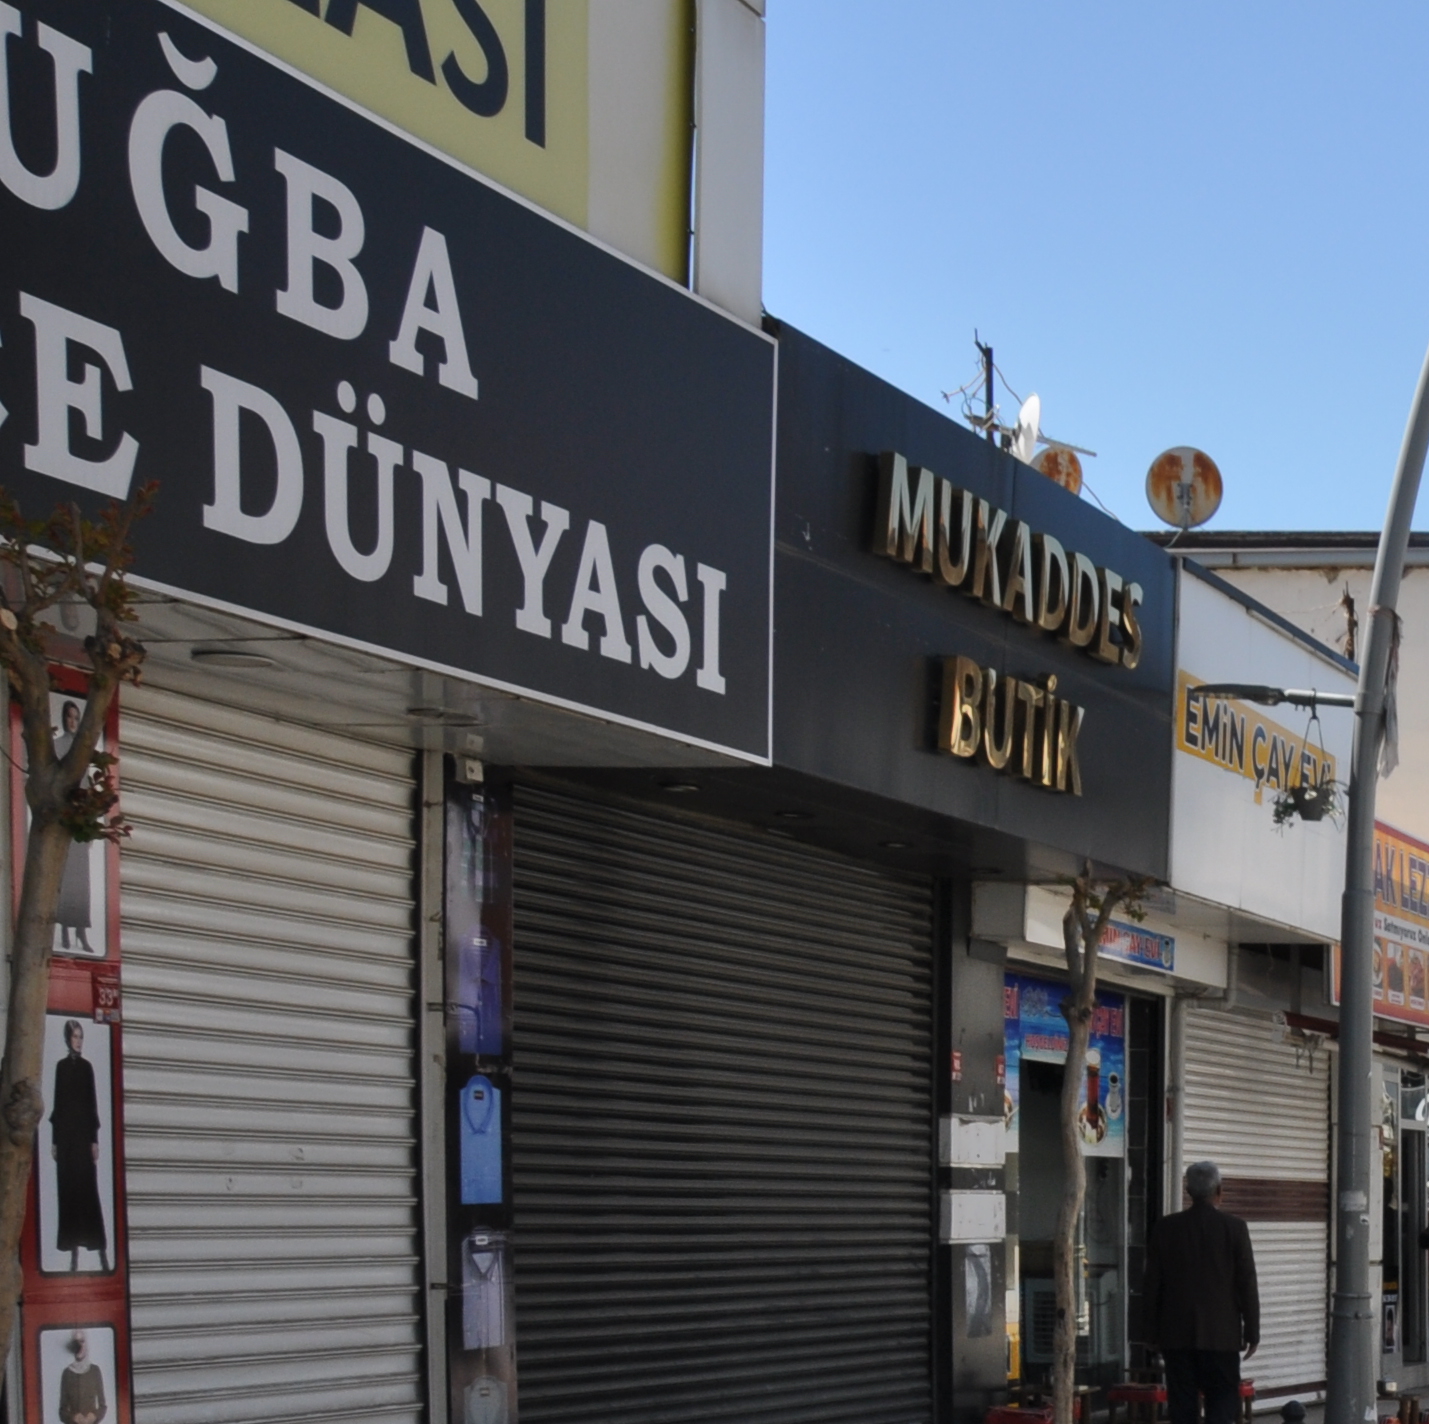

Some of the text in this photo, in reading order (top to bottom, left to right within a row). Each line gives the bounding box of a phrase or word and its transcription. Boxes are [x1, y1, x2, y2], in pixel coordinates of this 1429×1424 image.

[0, 290, 727, 695] E DÜNYASI
[879, 451, 1144, 669] MUKADDES
[942, 655, 1085, 796] BUTİK
[1185, 686, 1246, 773] EMİN
[1252, 725, 1295, 792] ÇAY
[1374, 839, 1397, 908] AK
